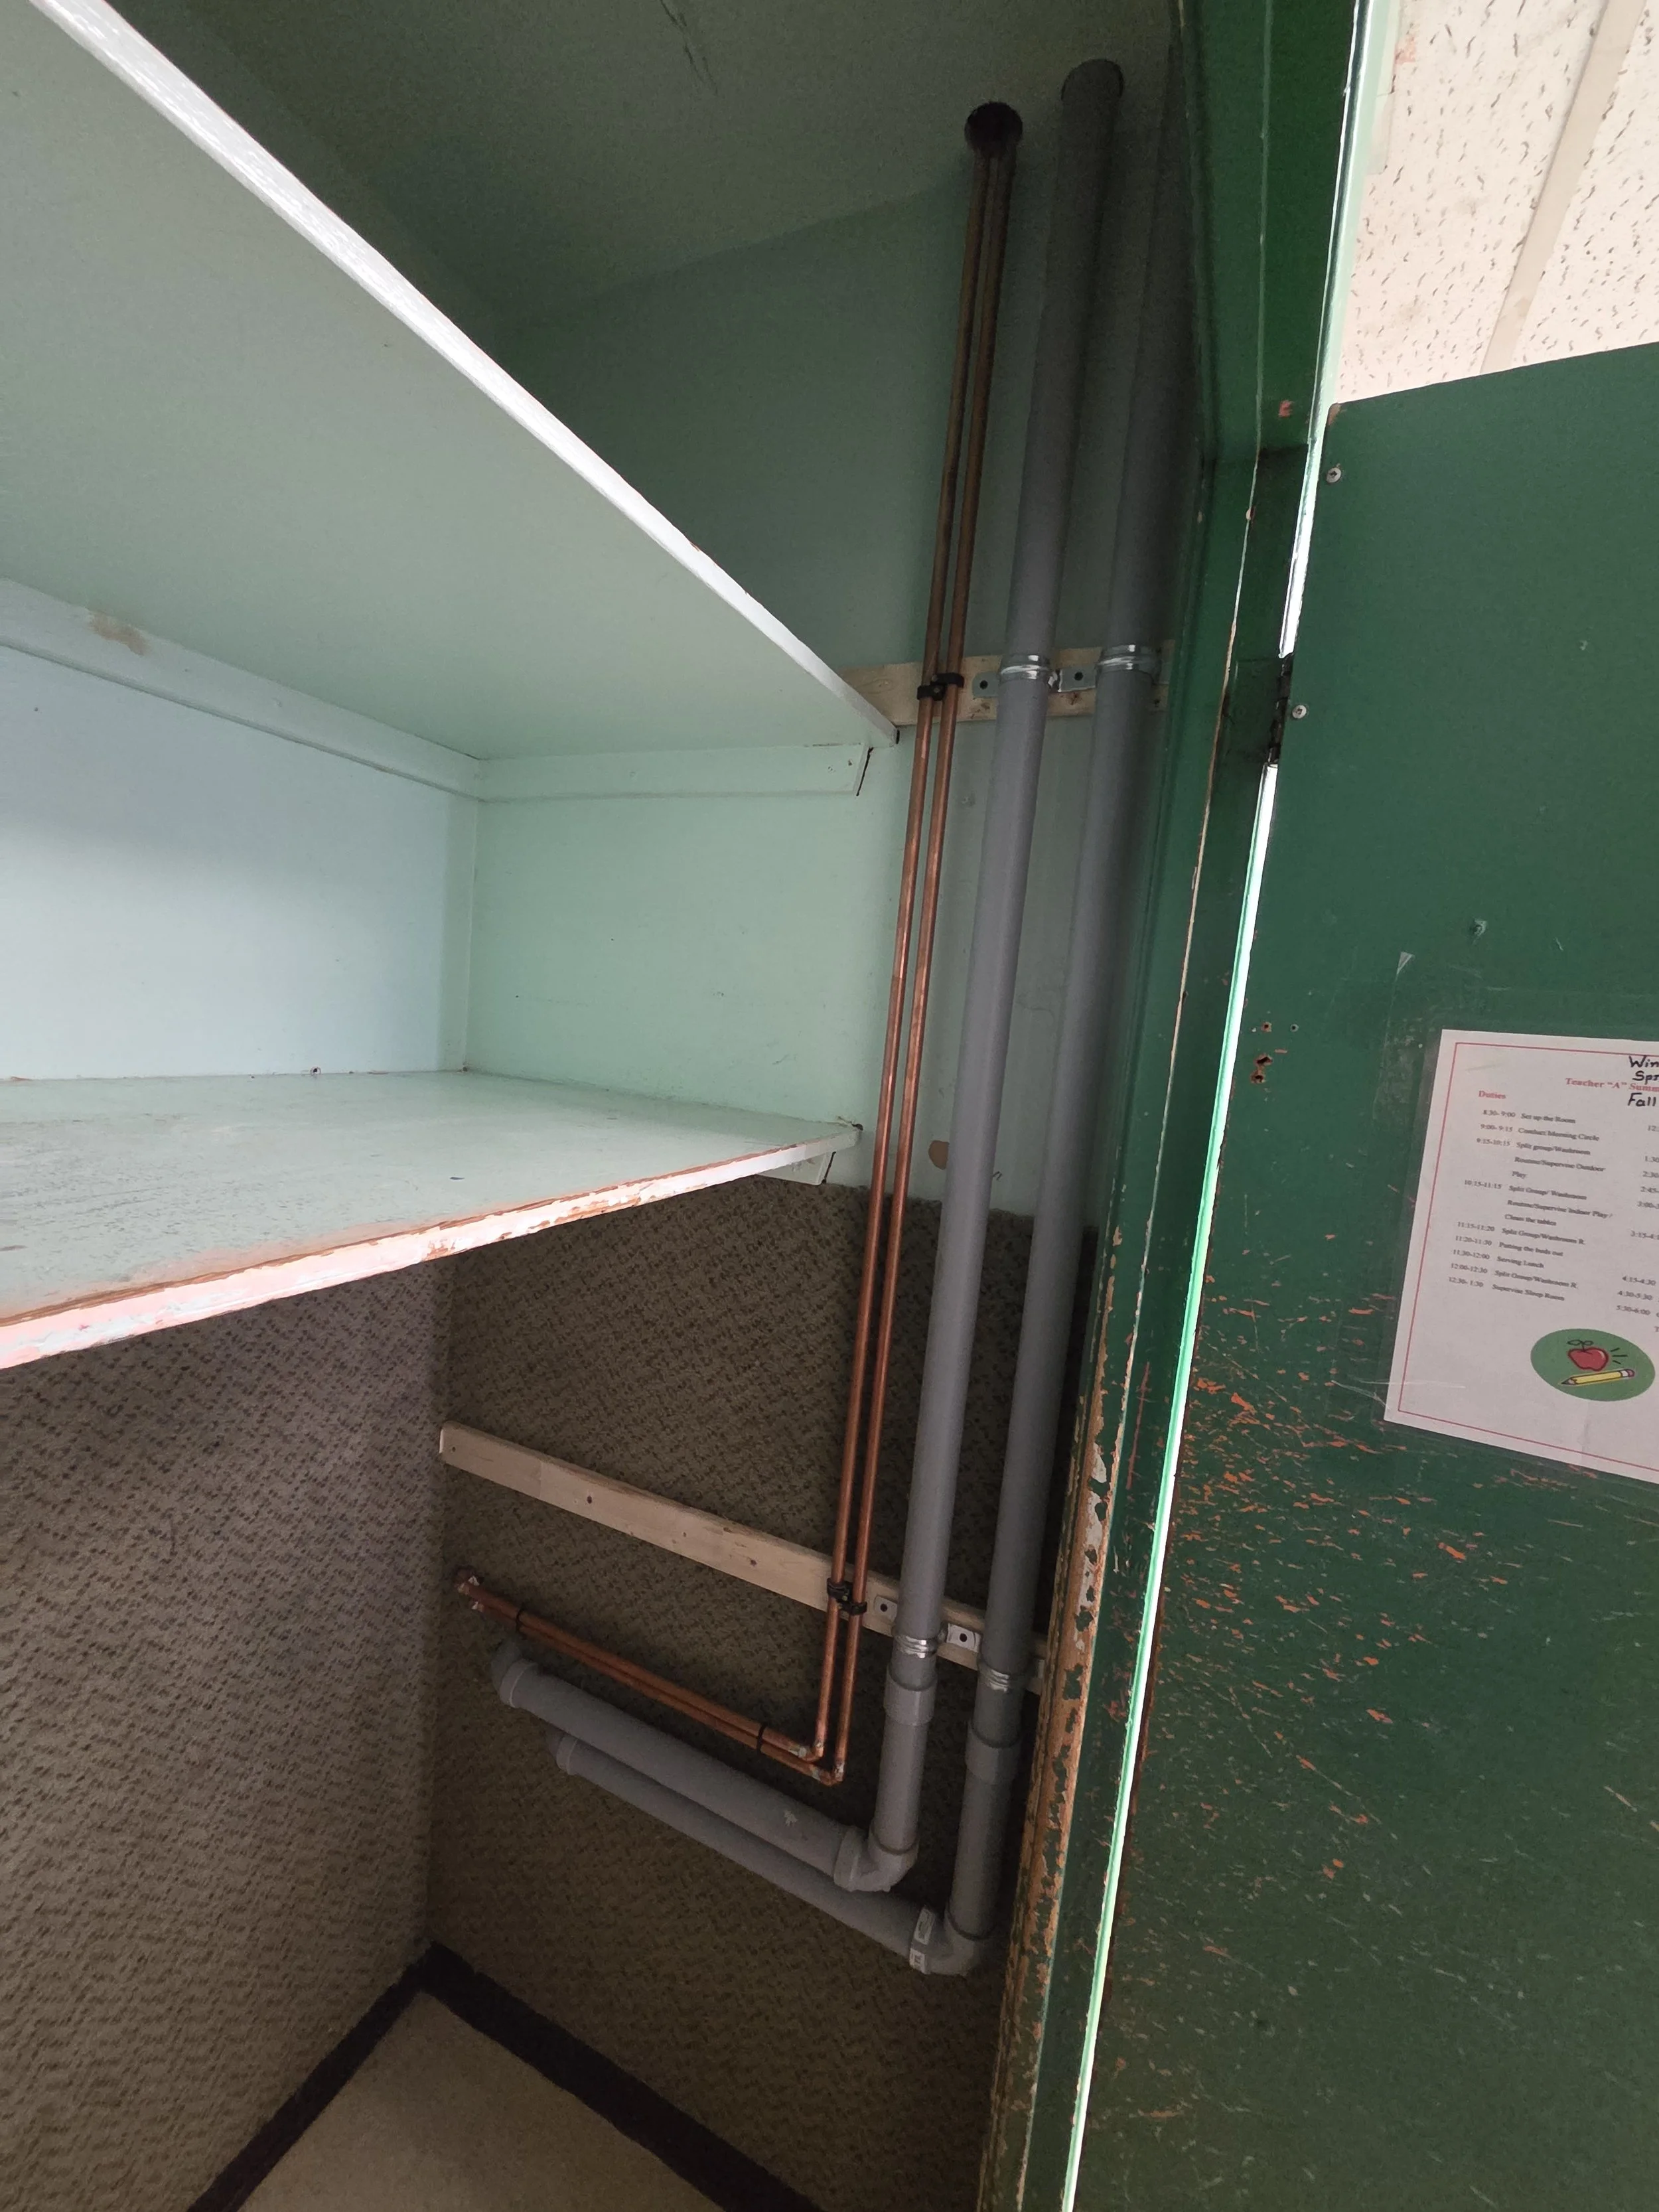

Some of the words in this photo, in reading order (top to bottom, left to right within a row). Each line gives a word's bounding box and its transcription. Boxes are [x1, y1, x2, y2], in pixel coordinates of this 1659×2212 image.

[1566, 1077, 1605, 1088] Teacher
[1479, 1090, 1506, 1100] Duties
[1627, 1092, 1656, 1107] Fall
[1548, 1130, 1577, 1140] Morning
[1575, 1163, 1606, 1172] Outdoor
[1512, 1171, 1527, 1179] Play
[1592, 1211, 1608, 1219] Play
[1498, 1242, 1522, 1252] Putting
[1497, 1256, 1522, 1266] Serving
[1524, 1260, 1545, 1268] Lunch
[1491, 1284, 1524, 1295] Supervise
[1525, 1290, 1544, 1299] Sleep
[1544, 1293, 1565, 1301] Room
